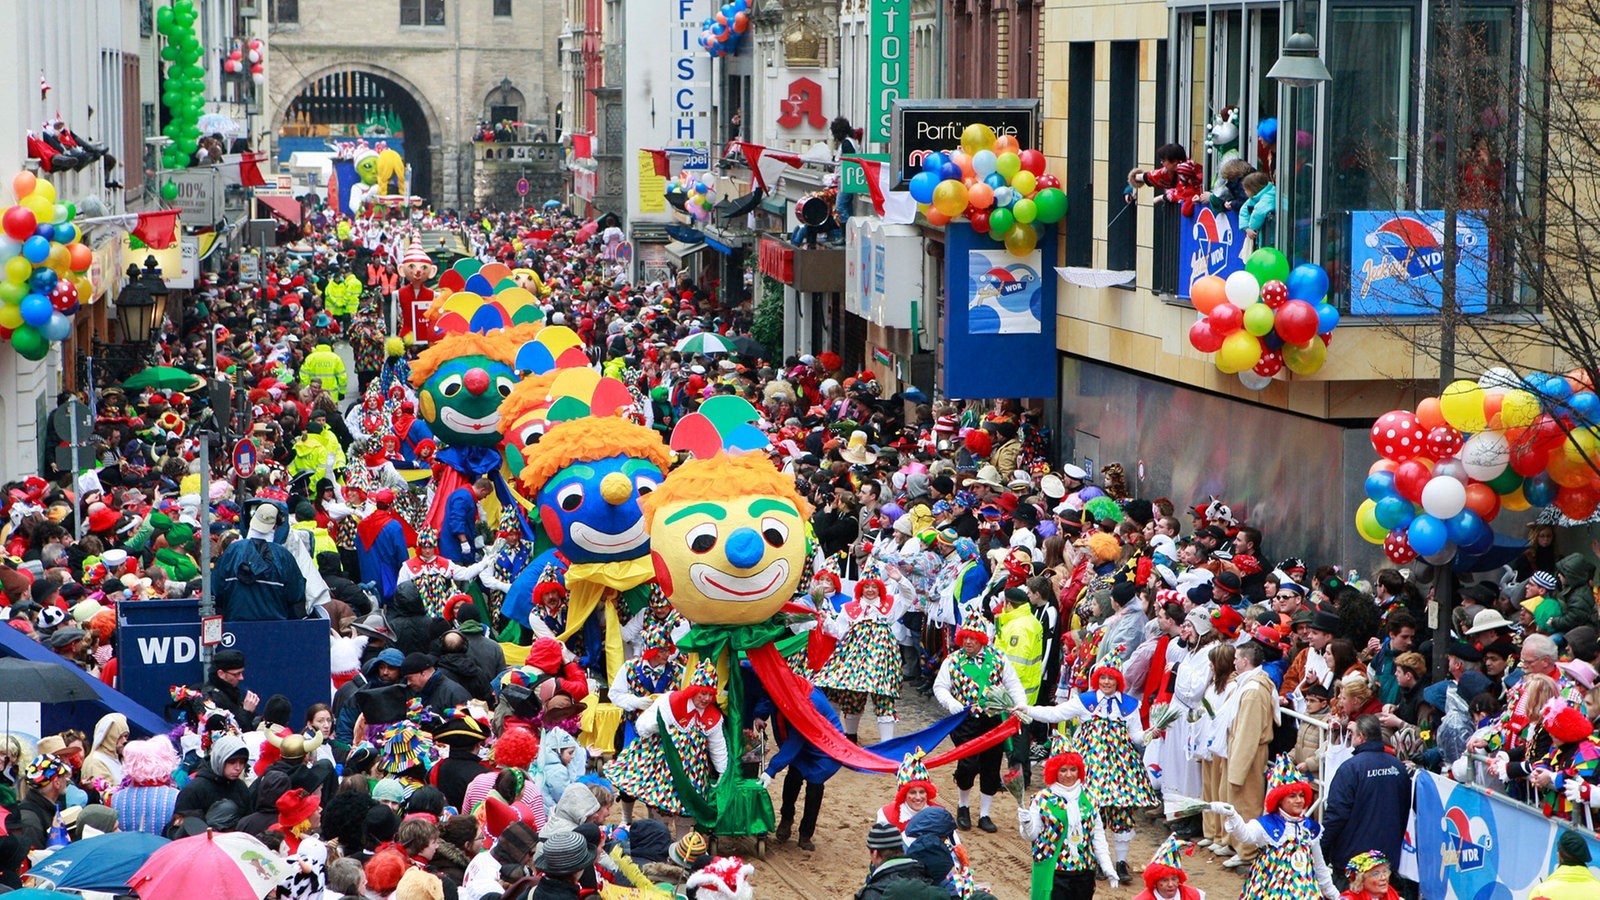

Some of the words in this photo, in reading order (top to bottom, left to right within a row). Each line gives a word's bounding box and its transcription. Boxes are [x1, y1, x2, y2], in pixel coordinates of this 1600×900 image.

[676, 0, 694, 139] FISCH
[917, 121, 1018, 140] Parfüerie
[175, 182, 206, 199] 00%
[1417, 251, 1445, 269] WD
[1005, 283, 1023, 293] WDR
[1367, 768, 1392, 777] LUCHS
[1462, 848, 1479, 862] WDR
